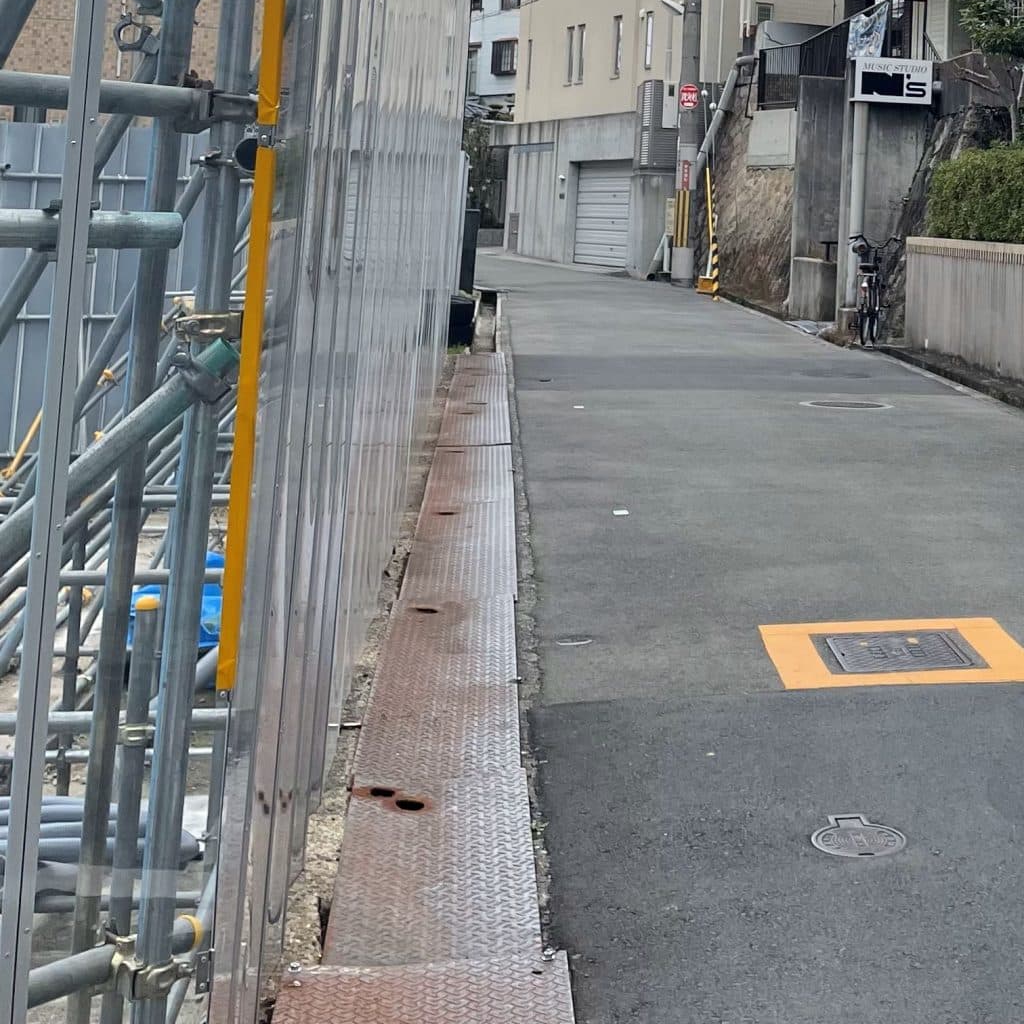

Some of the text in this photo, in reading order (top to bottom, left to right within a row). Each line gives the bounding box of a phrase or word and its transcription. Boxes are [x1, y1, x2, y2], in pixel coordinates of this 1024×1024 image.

[862, 62, 928, 74] MUSIC STUDIO
[861, 71, 927, 98] N's
